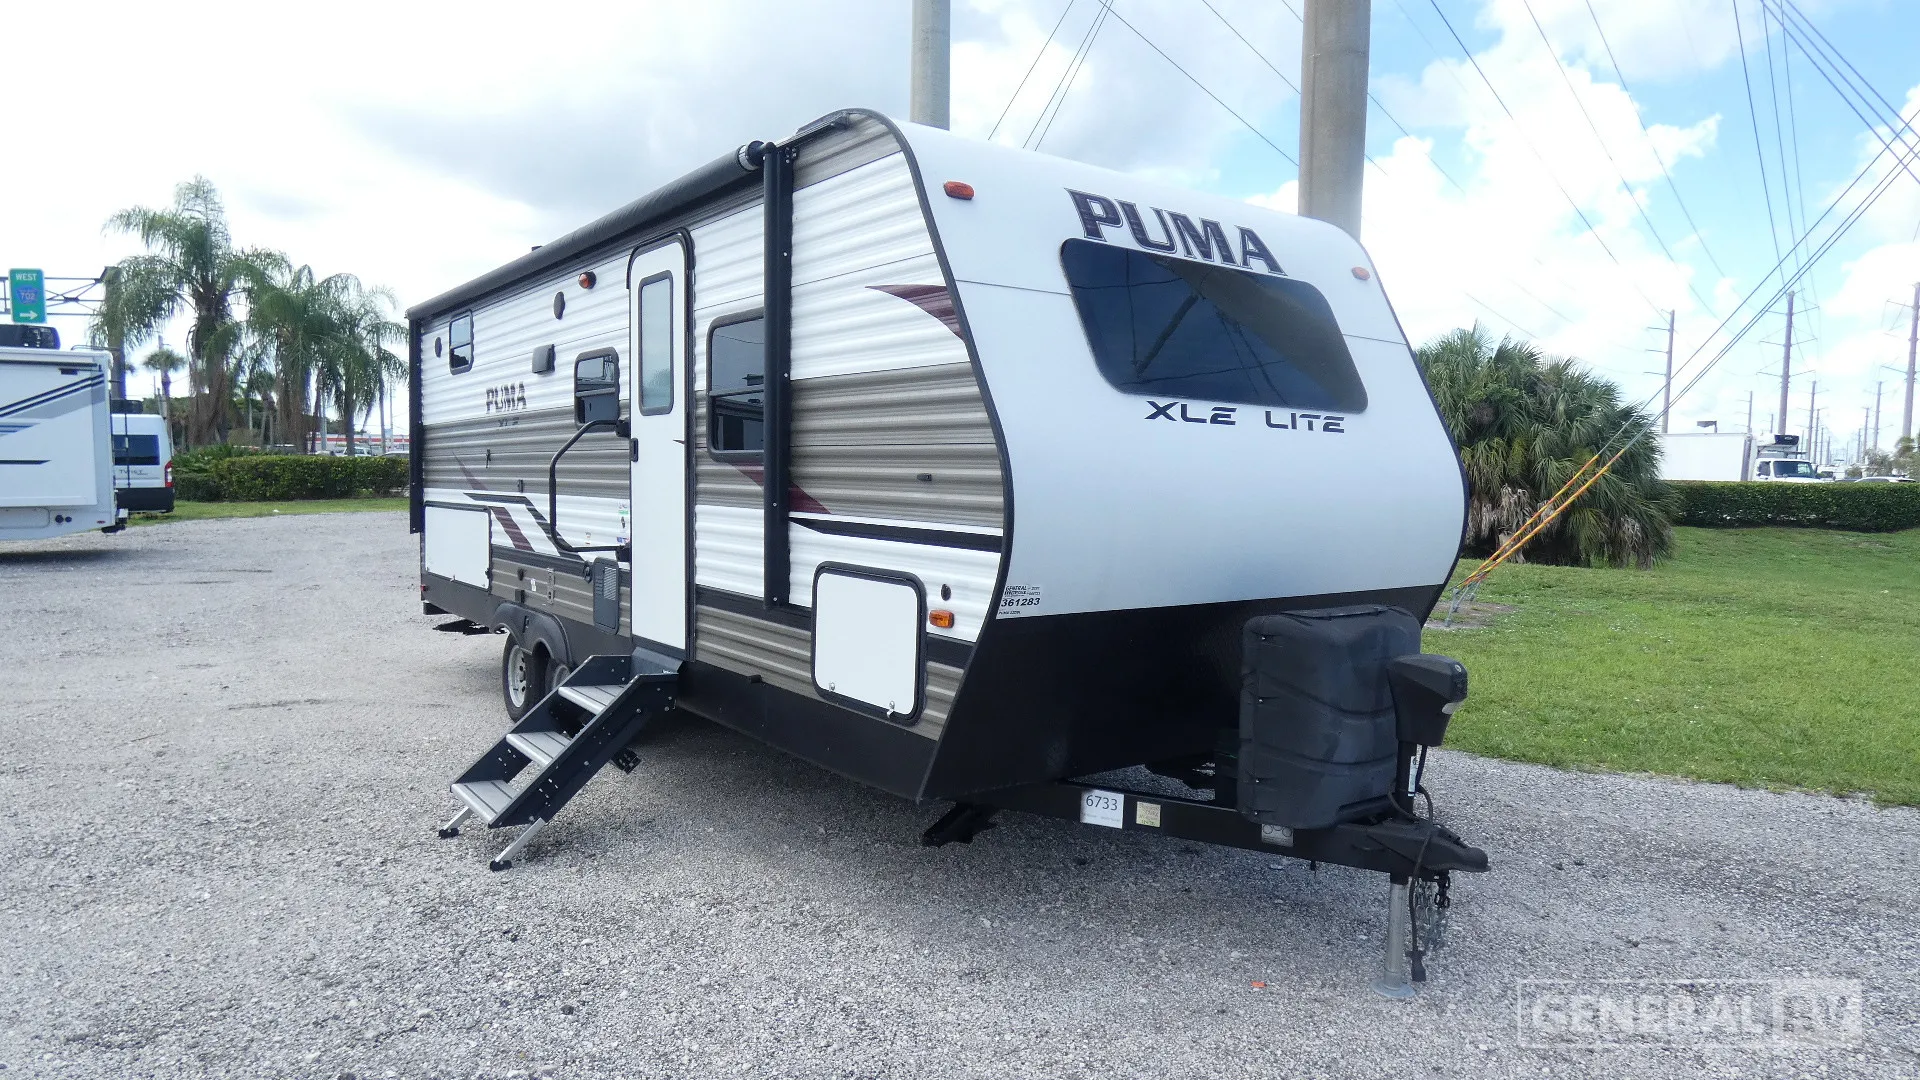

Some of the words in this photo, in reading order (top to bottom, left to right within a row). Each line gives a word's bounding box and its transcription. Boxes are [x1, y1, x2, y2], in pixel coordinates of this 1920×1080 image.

[1064, 188, 1288, 276] PUMA
[15, 273, 37, 281] WEST
[21, 292, 36, 301] 702
[486, 381, 527, 414] PUMA
[1144, 400, 1237, 426] XLE
[1265, 410, 1345, 434] LITE
[1001, 597, 1040, 607] 361283
[1086, 794, 1118, 811] 6733
